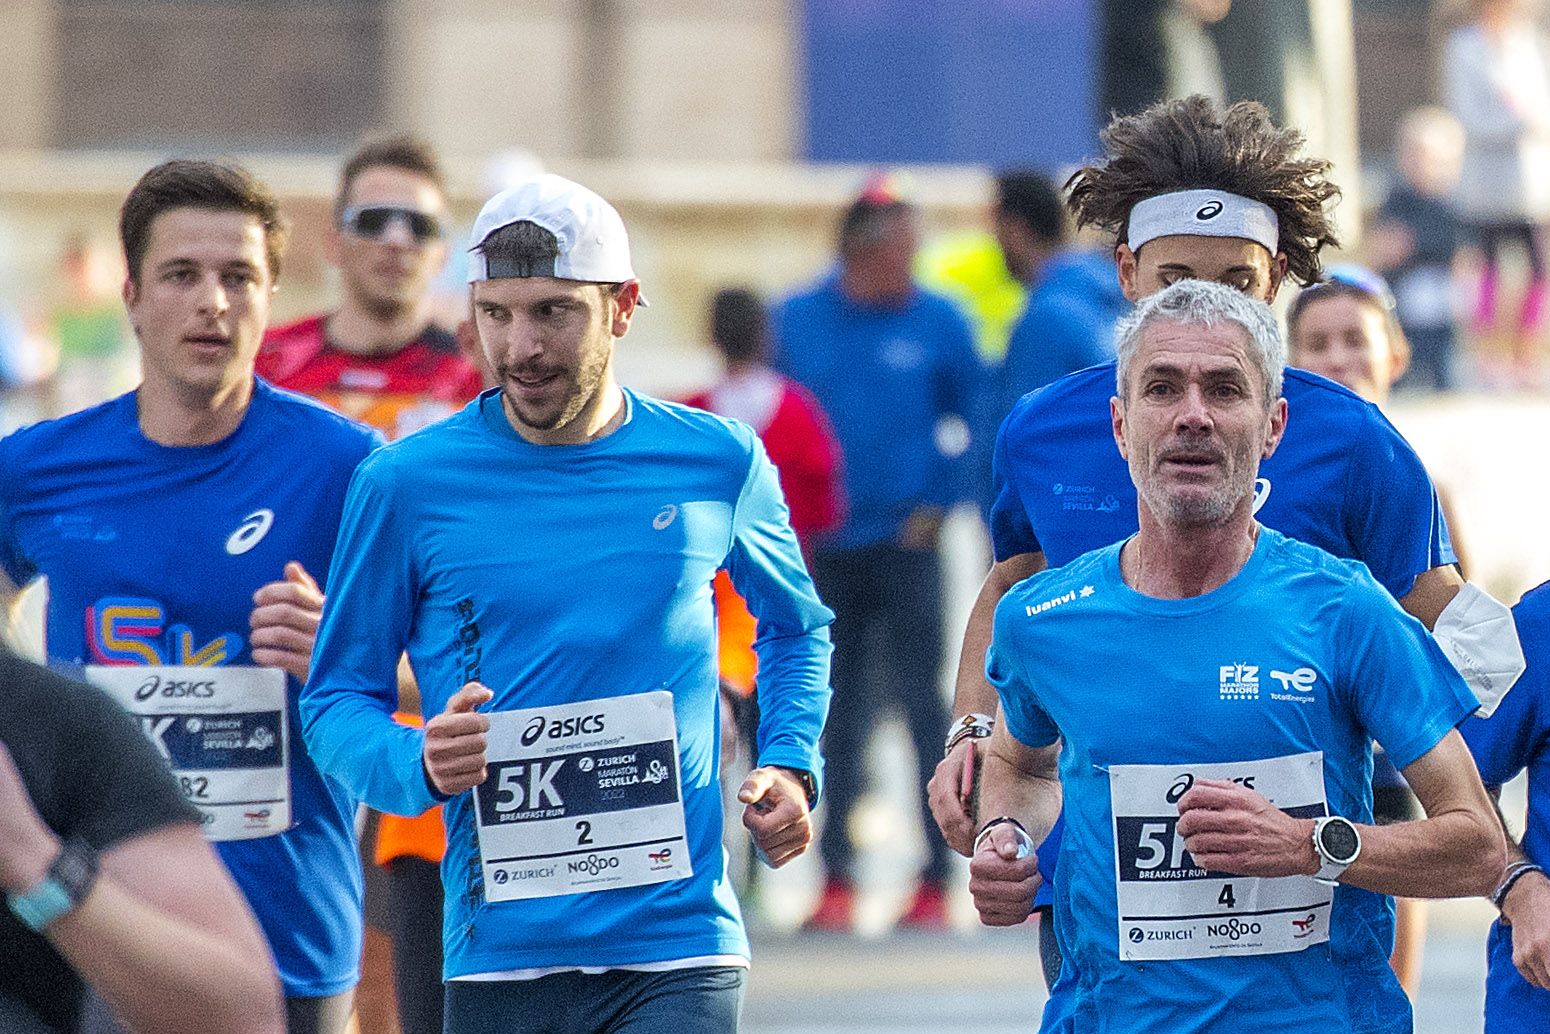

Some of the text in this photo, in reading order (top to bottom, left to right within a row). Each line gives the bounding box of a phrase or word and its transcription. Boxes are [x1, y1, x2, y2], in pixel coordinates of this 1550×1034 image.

[1025, 590, 1076, 617] luanvi
[161, 680, 216, 698] asics
[547, 713, 605, 739] asics
[597, 753, 637, 767] ZURICH
[495, 758, 566, 812] 5K
[598, 775, 641, 789] SEVILLA
[500, 808, 565, 822] BREAKFAST RUN
[575, 820, 594, 846] 2
[511, 868, 554, 881] ZURICH
[1139, 868, 1208, 880] BREAKFAST RUN
[1217, 884, 1236, 909] 4
[1147, 930, 1193, 941] ZURICH
